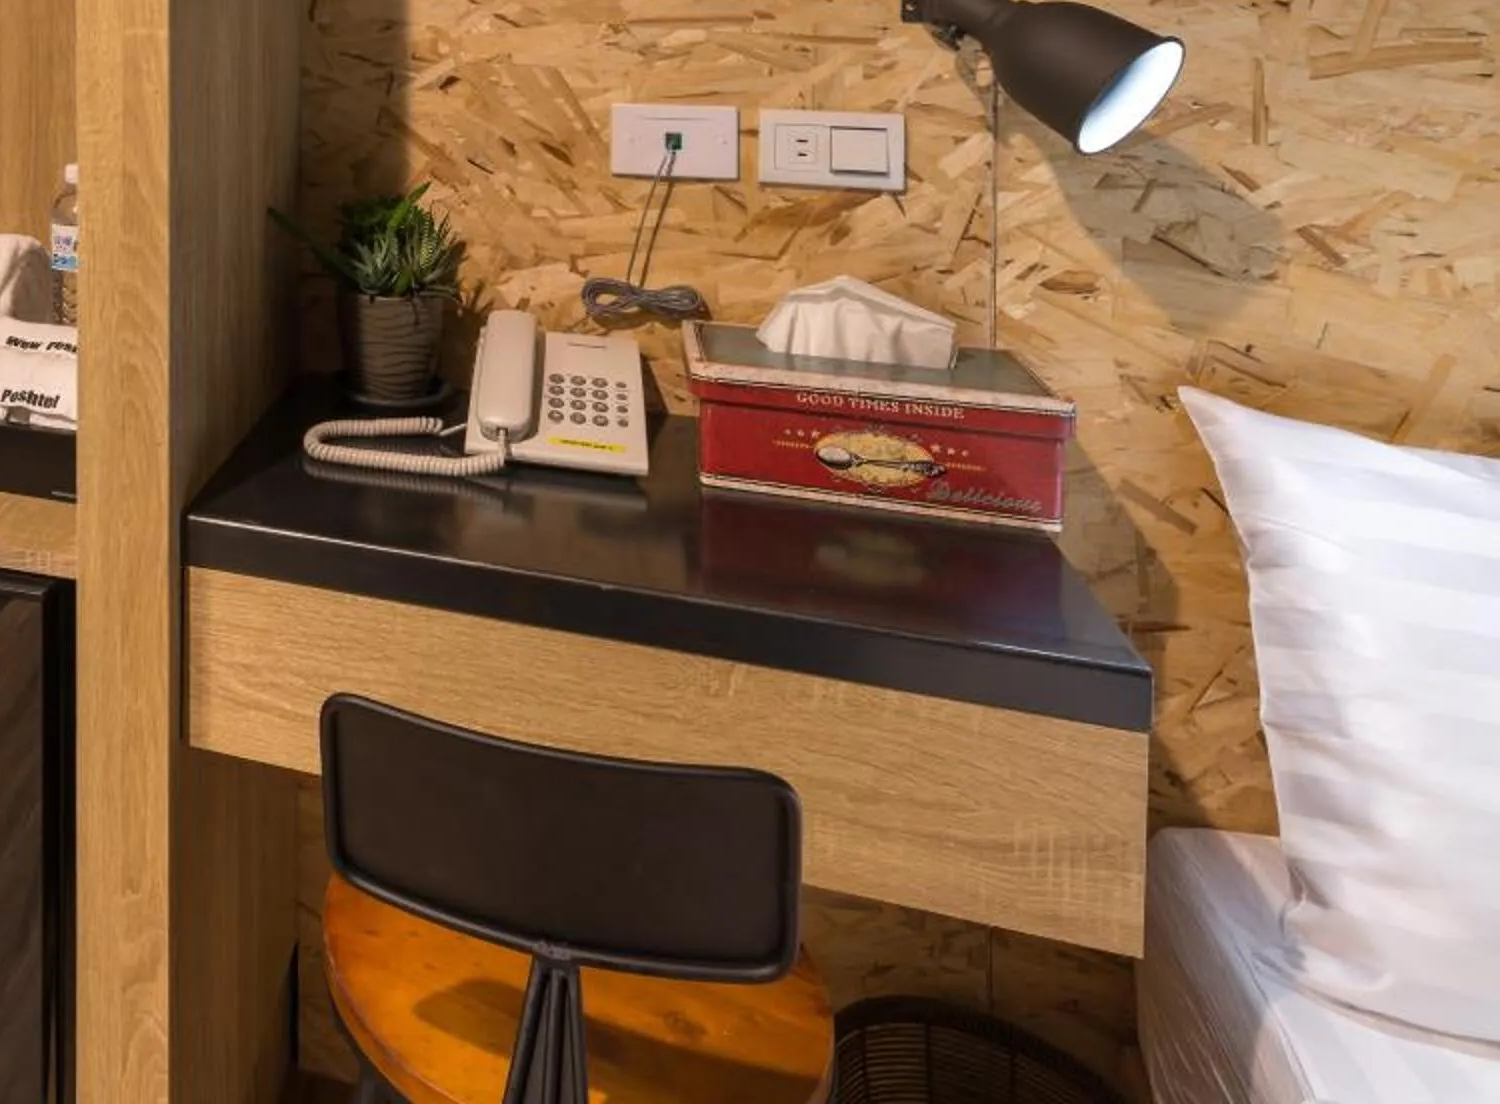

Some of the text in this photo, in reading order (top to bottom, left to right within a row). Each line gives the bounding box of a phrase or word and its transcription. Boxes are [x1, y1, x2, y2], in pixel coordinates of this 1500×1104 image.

[5, 335, 43, 350] Wow
[0, 389, 61, 409] Poshtel
[796, 392, 966, 420] GOOD TIMES INSIDE
